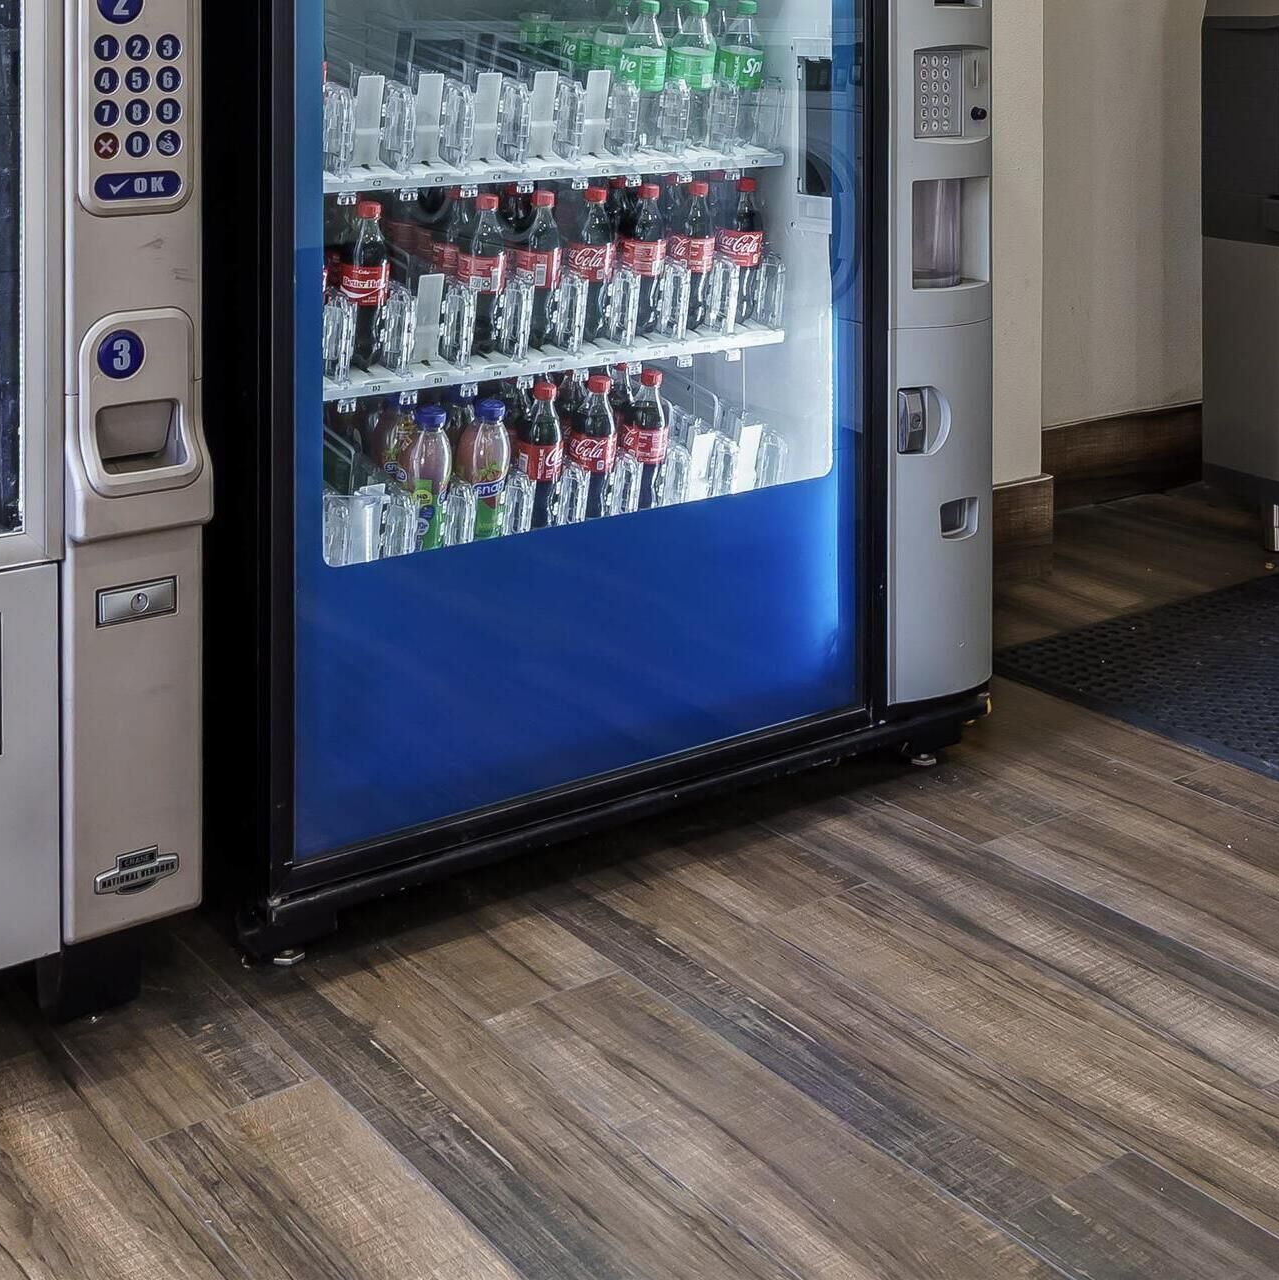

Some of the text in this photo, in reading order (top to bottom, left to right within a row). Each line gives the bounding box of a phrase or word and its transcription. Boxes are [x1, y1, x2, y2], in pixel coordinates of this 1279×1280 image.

[101, 40, 172, 56] 1 2 3
[134, 176, 165, 193] OK
[113, 339, 131, 370] 3
